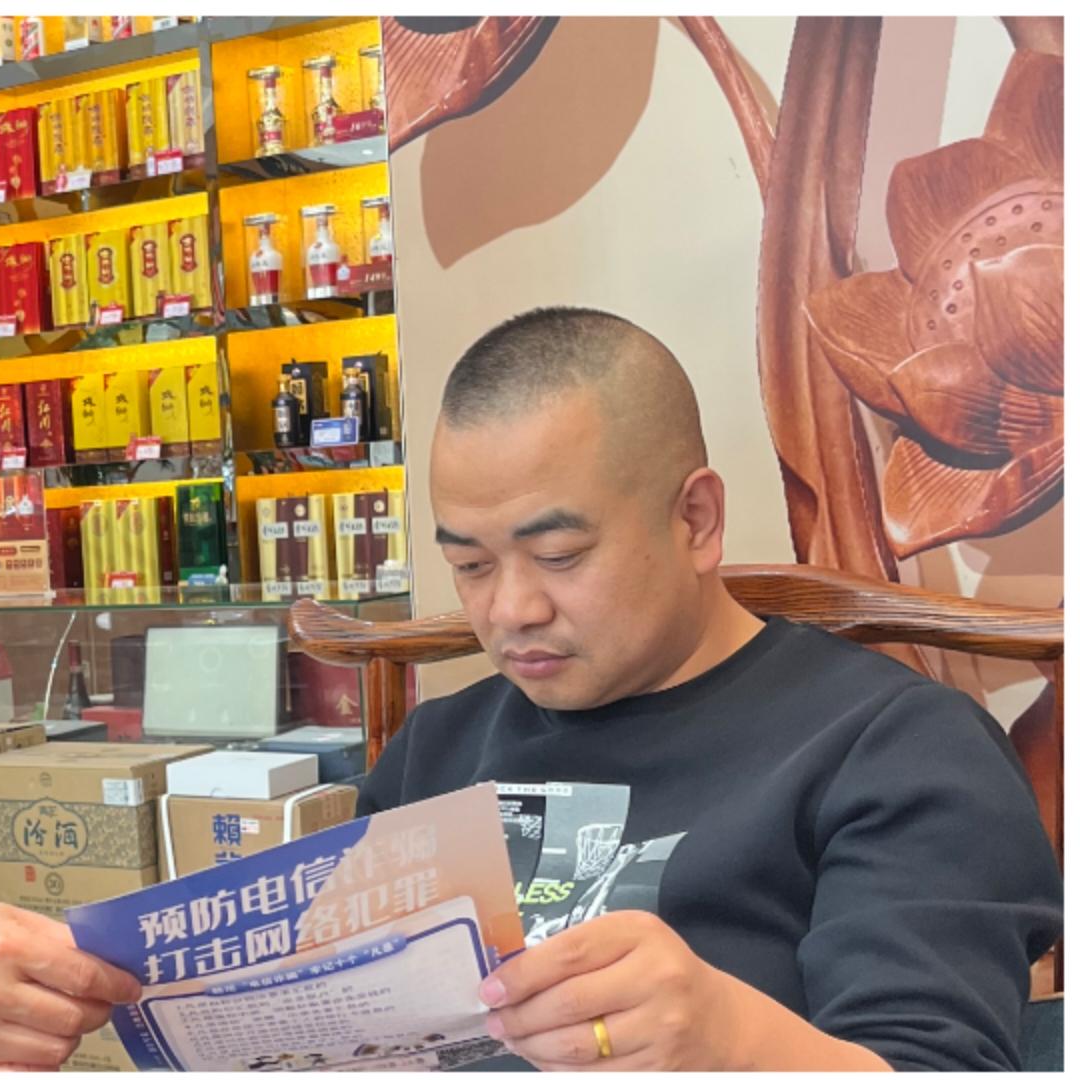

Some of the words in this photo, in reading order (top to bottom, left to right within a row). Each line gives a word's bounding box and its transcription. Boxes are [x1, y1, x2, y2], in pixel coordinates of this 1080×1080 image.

[23, 819, 79, 850] 汾酒
[138, 824, 438, 949] 预防电信诈骗
[144, 867, 440, 985] 打击网络犯罪
